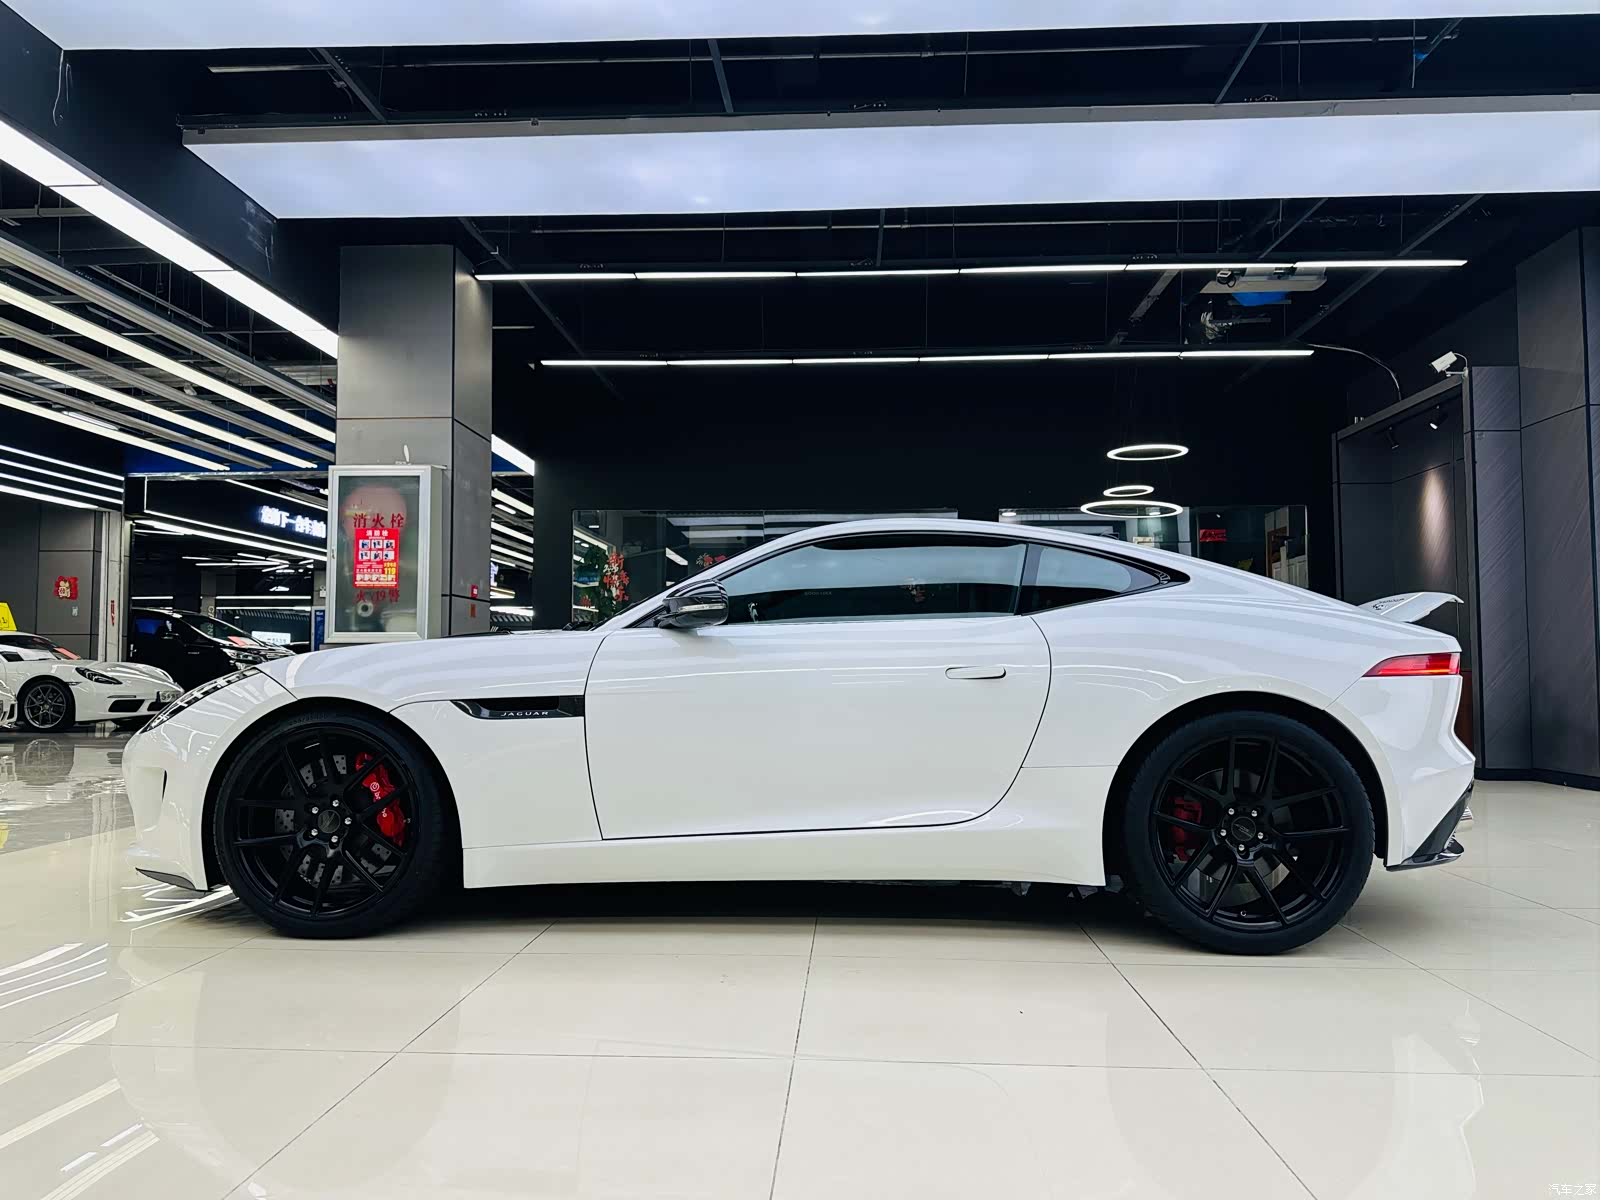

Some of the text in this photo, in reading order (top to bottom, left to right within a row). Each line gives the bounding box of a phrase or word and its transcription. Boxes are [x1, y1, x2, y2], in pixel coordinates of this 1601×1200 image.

[353, 512, 405, 528] 消火栓
[384, 567, 396, 575] 119
